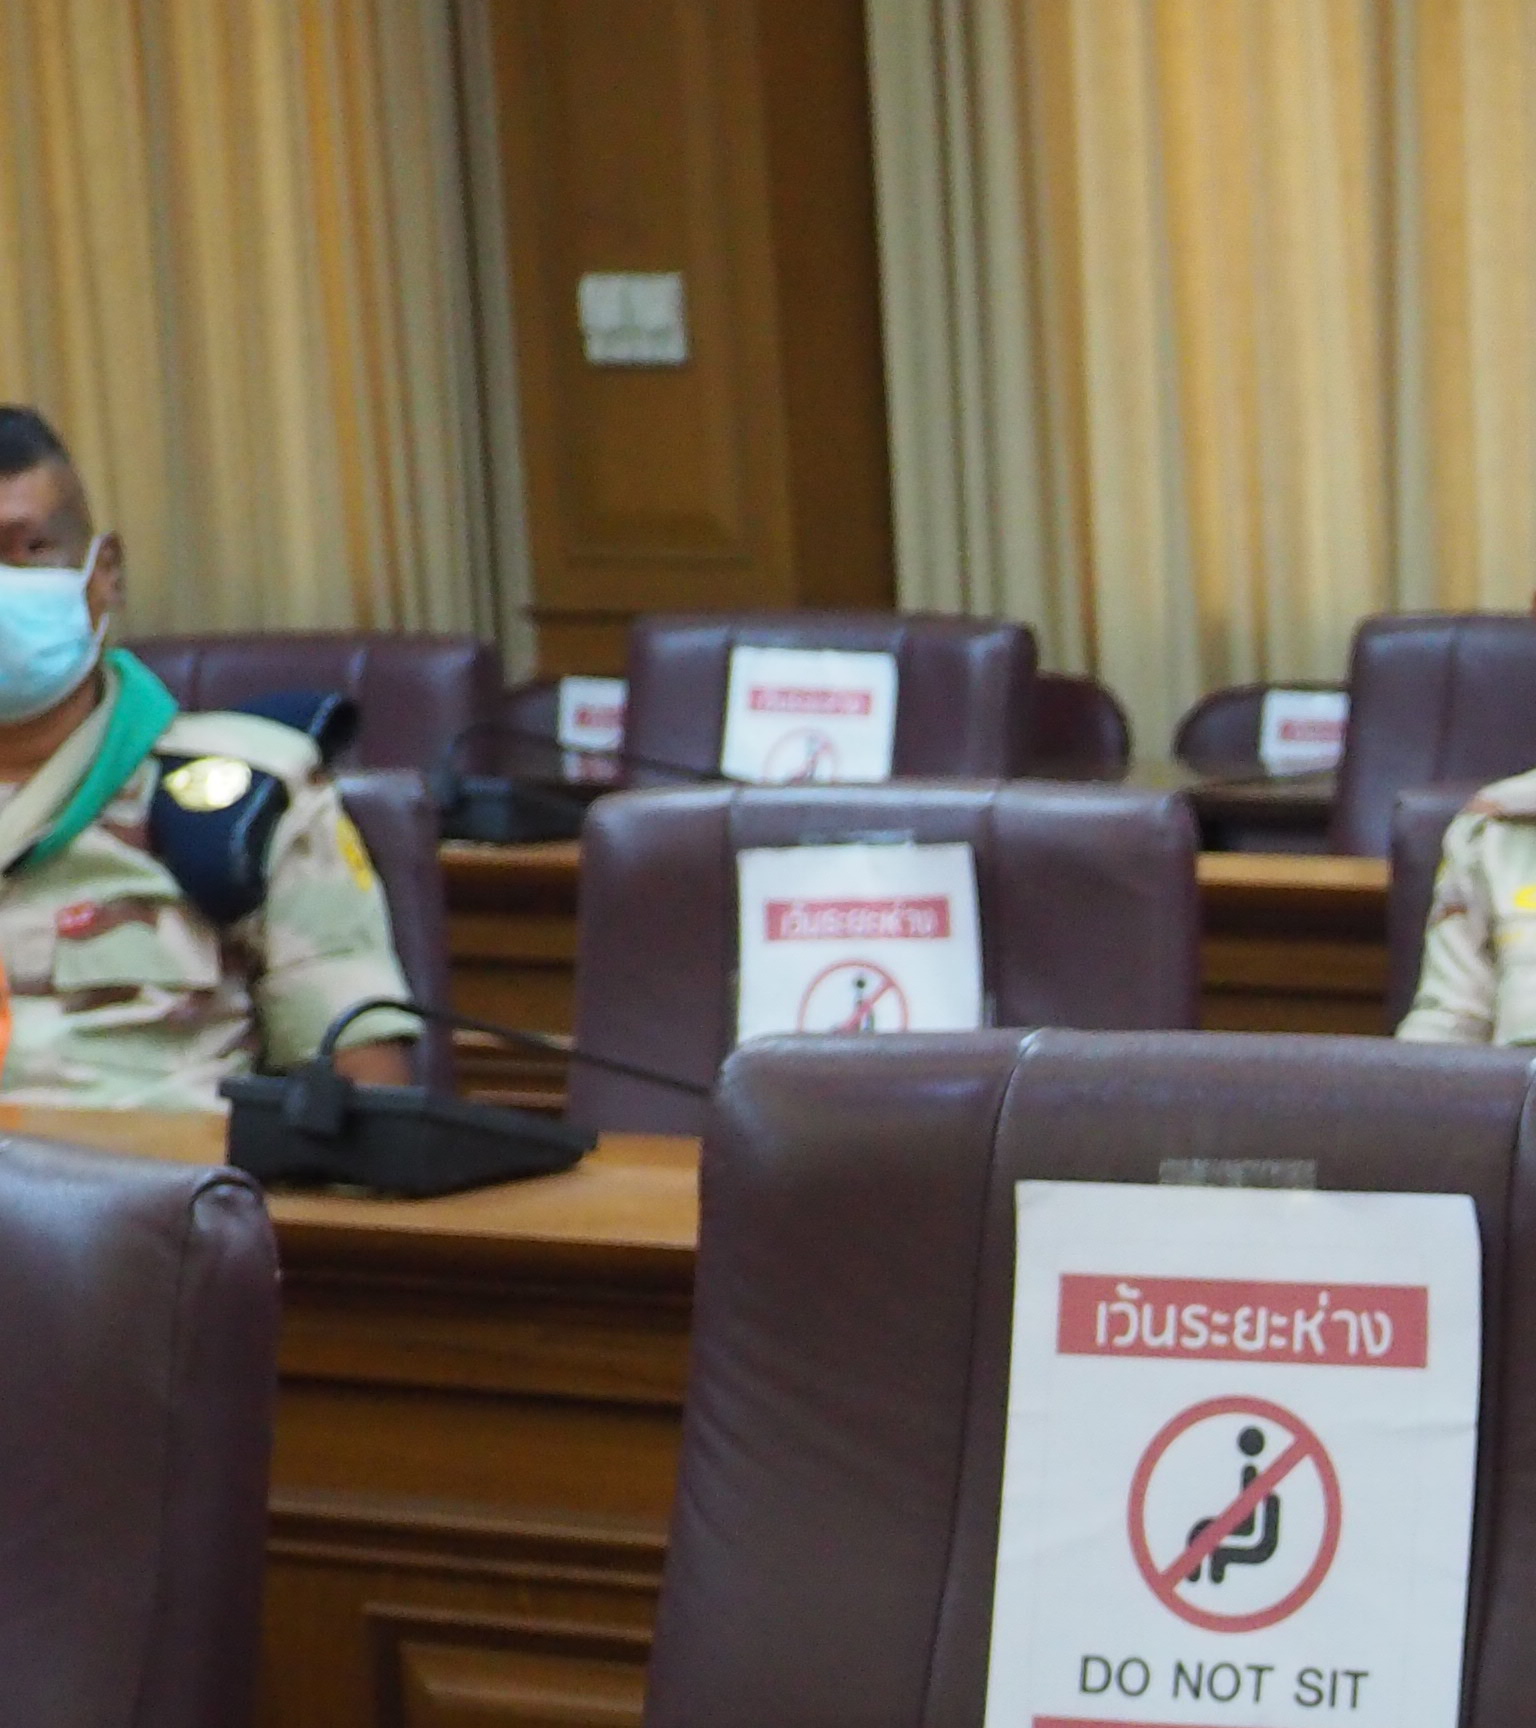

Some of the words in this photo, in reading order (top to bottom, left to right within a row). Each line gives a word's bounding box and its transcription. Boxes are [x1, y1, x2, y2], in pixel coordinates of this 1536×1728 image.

[1096, 1281, 1394, 1357] เว้นระยะห่าง
[1079, 1654, 1150, 1698] DO
[1171, 1659, 1275, 1704] NOT
[1293, 1666, 1370, 1709] SIT
